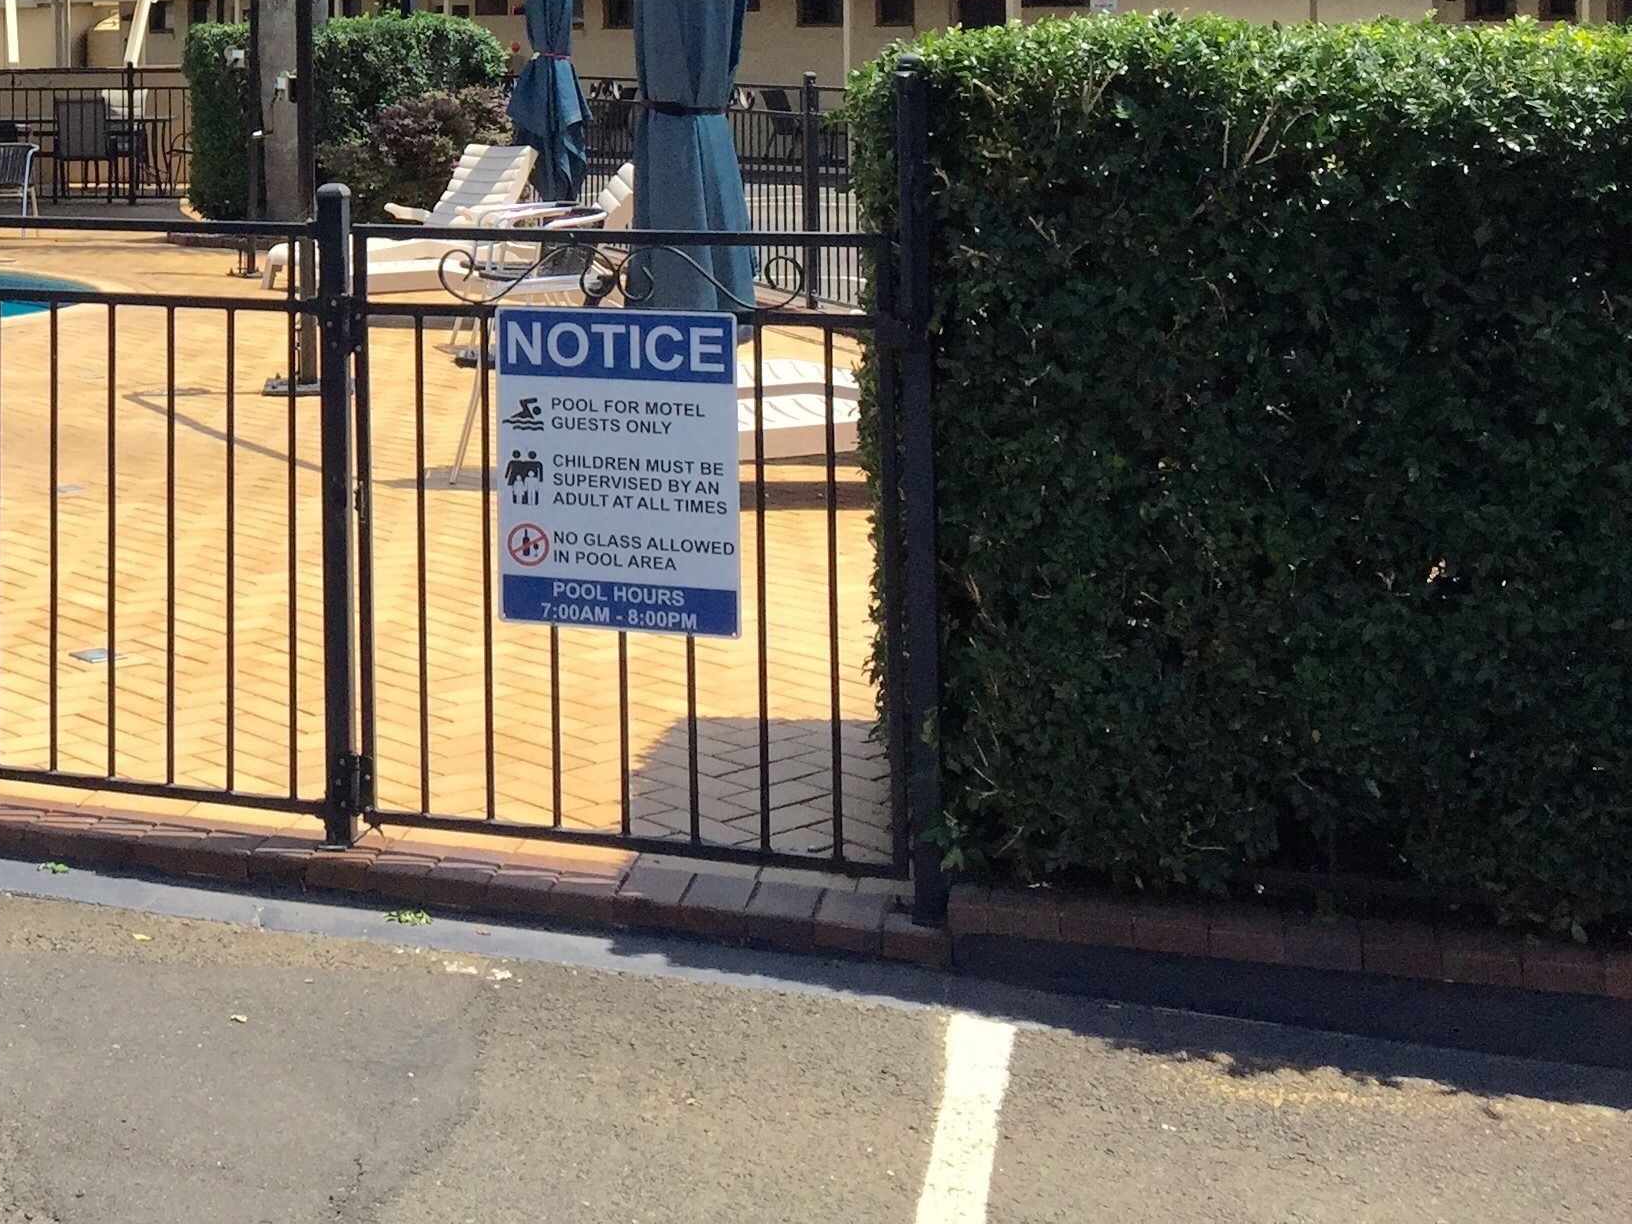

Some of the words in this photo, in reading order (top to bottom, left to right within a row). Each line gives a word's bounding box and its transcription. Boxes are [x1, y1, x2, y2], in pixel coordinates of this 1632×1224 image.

[506, 321, 725, 373] NOTICE
[552, 397, 598, 413] POOL
[605, 400, 639, 415] FOR
[645, 402, 705, 417] MOTEL
[551, 416, 621, 432] GUESTS
[626, 420, 672, 434] ONLY
[553, 454, 640, 471] CHILDREN
[646, 458, 694, 474] MUST
[701, 462, 724, 476] BE
[553, 473, 662, 491] SUPERVISED
[668, 479, 691, 493] BY
[695, 480, 719, 495] AN
[553, 492, 608, 508] ADULT
[612, 495, 633, 509] AT
[637, 496, 670, 512] ALL
[674, 499, 728, 515] TIMES
[553, 531, 578, 545] NO
[584, 533, 642, 549] GLASS
[646, 537, 735, 556] ALLOWED
[553, 550, 569, 563] IN
[576, 551, 623, 567] POOL
[627, 554, 677, 571] AREA
[553, 581, 607, 601] POOL
[614, 585, 685, 607] HOURS
[541, 602, 610, 623] 7:00AM
[628, 610, 697, 630] 8:00PM
